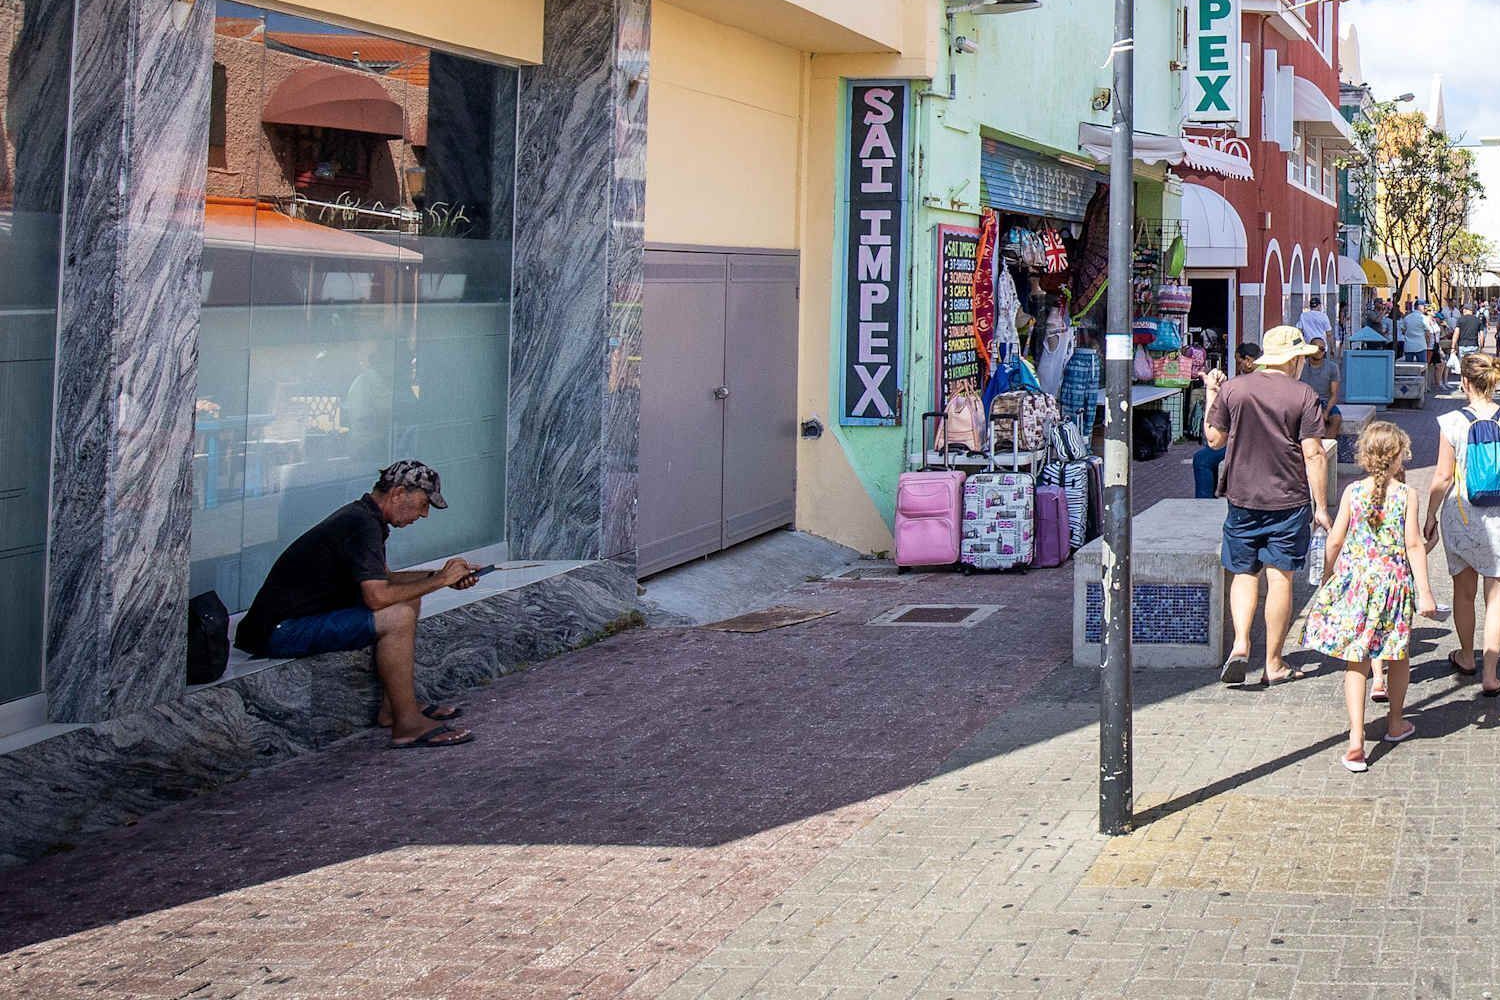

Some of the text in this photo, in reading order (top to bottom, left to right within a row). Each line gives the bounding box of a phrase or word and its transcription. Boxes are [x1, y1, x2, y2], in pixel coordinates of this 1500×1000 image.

[851, 88, 896, 417] SAI IMPEX
[948, 240, 977, 258] SAI IMPEX
[954, 285, 967, 297] CAPS
